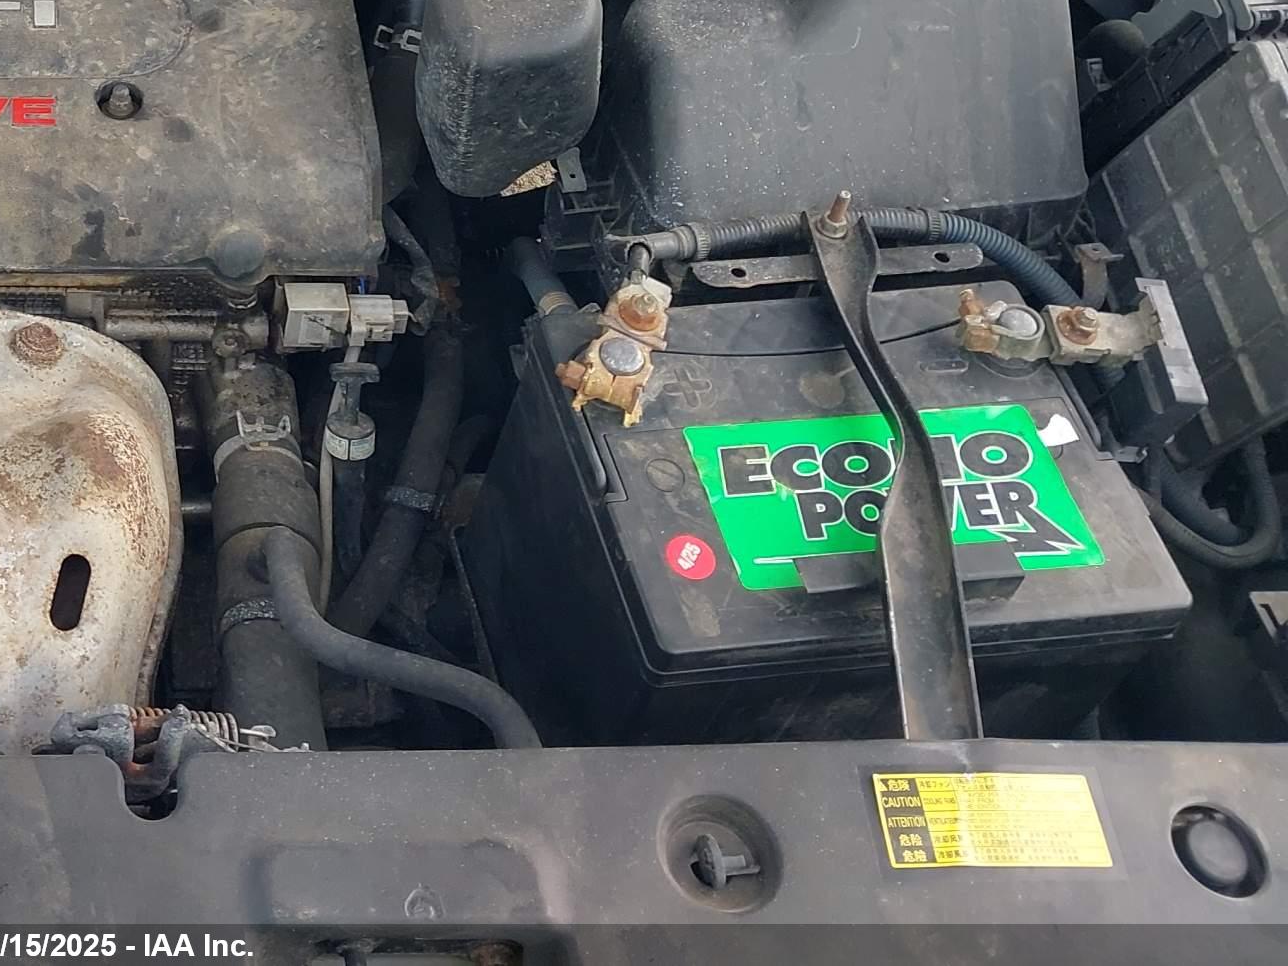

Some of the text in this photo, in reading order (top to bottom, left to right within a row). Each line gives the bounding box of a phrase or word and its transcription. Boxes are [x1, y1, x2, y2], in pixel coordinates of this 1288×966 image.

[795, 480, 1052, 542] POER
[882, 796, 922, 808] CAUTION
[888, 817, 926, 828] ATTENTION
